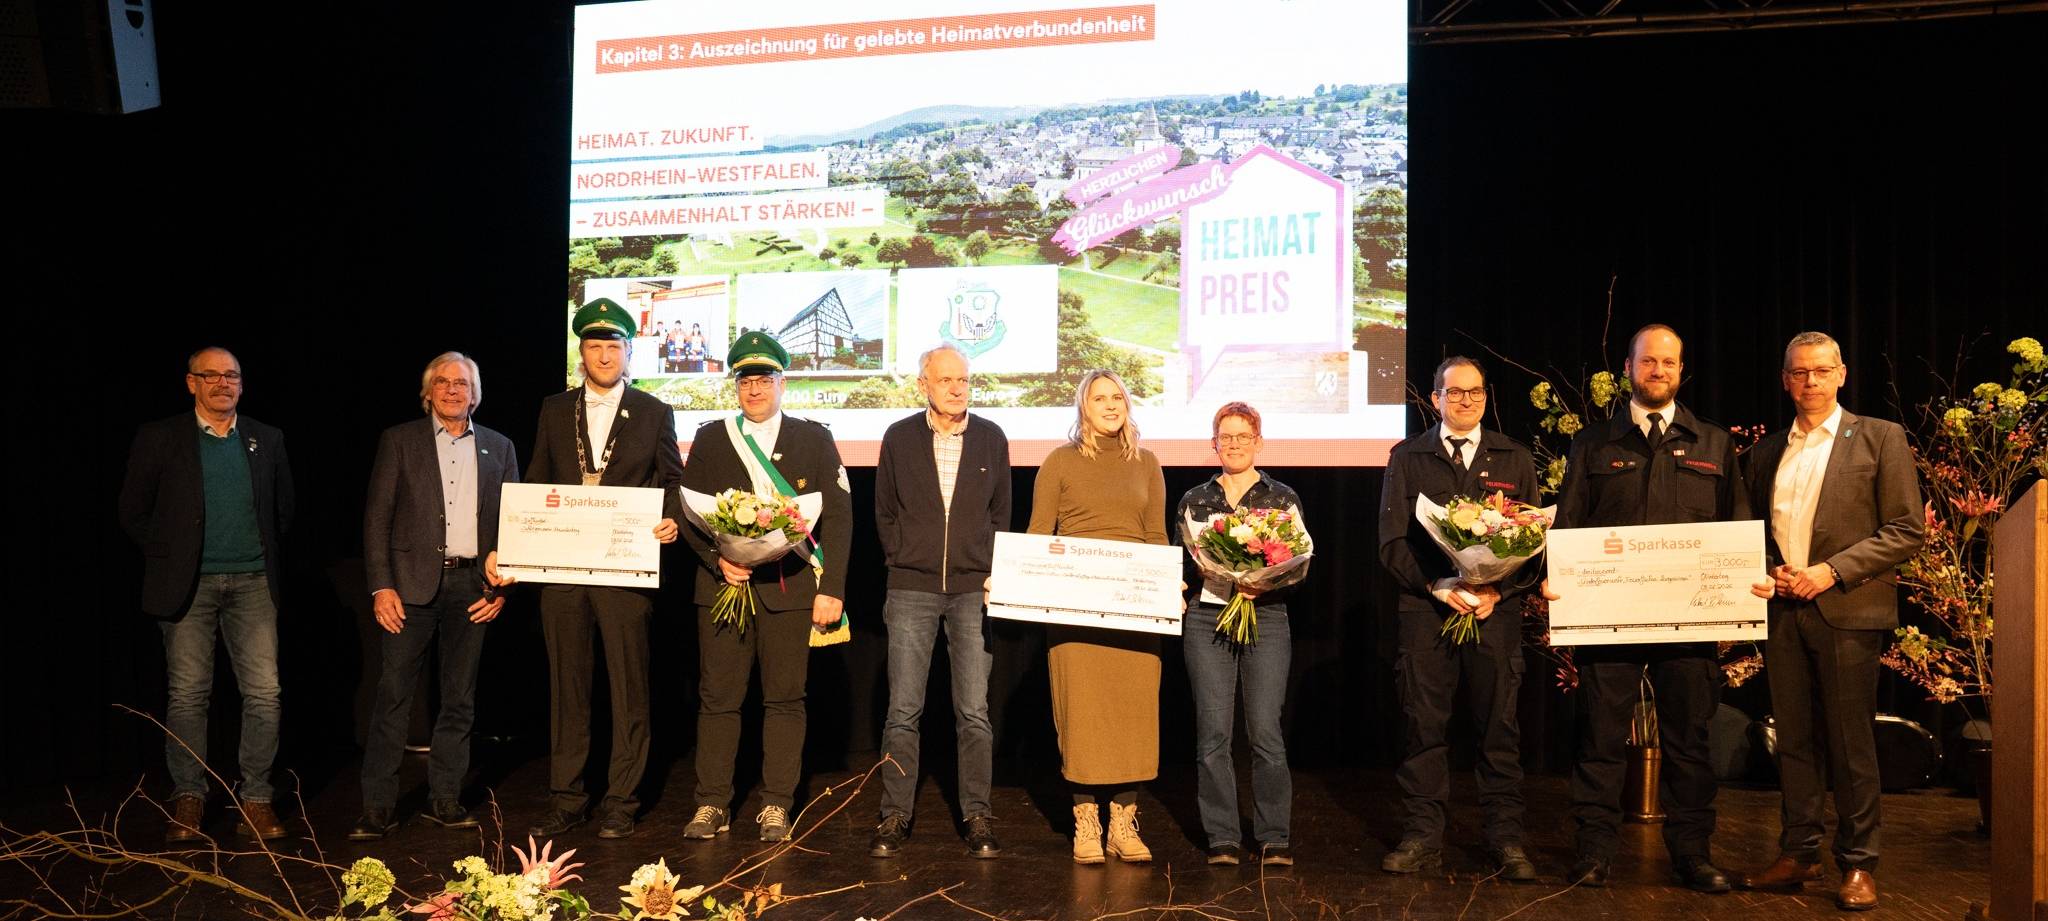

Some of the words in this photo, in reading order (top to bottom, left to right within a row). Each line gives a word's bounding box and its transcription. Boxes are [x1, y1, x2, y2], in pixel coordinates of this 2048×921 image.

[601, 46, 662, 67] Kapitel
[669, 44, 684, 60] 3:
[690, 36, 817, 59] Auszeichnung
[824, 33, 848, 50] für
[854, 30, 925, 51] gelebte
[932, 15, 1146, 43] Heimatverbundenheit
[578, 131, 654, 149] HEIMAT.
[661, 125, 754, 145] ZUKUNFT.
[577, 162, 821, 189] NORDRHEIN-WESTFALEN.
[1080, 151, 1169, 198] HERZLICHEN
[593, 205, 752, 228] ZUSAMMENHALT
[758, 200, 856, 220] STÄRKEN!
[1064, 165, 1230, 249] Glückwunsch
[1201, 212, 1321, 261] HEIMAT
[1201, 270, 1290, 315] PREIS
[661, 393, 693, 405] Euro
[814, 390, 849, 404] Euro
[564, 496, 619, 508] Sparkasse
[1070, 545, 1133, 559] Sparkasse
[1628, 538, 1702, 553] Sparkasse
